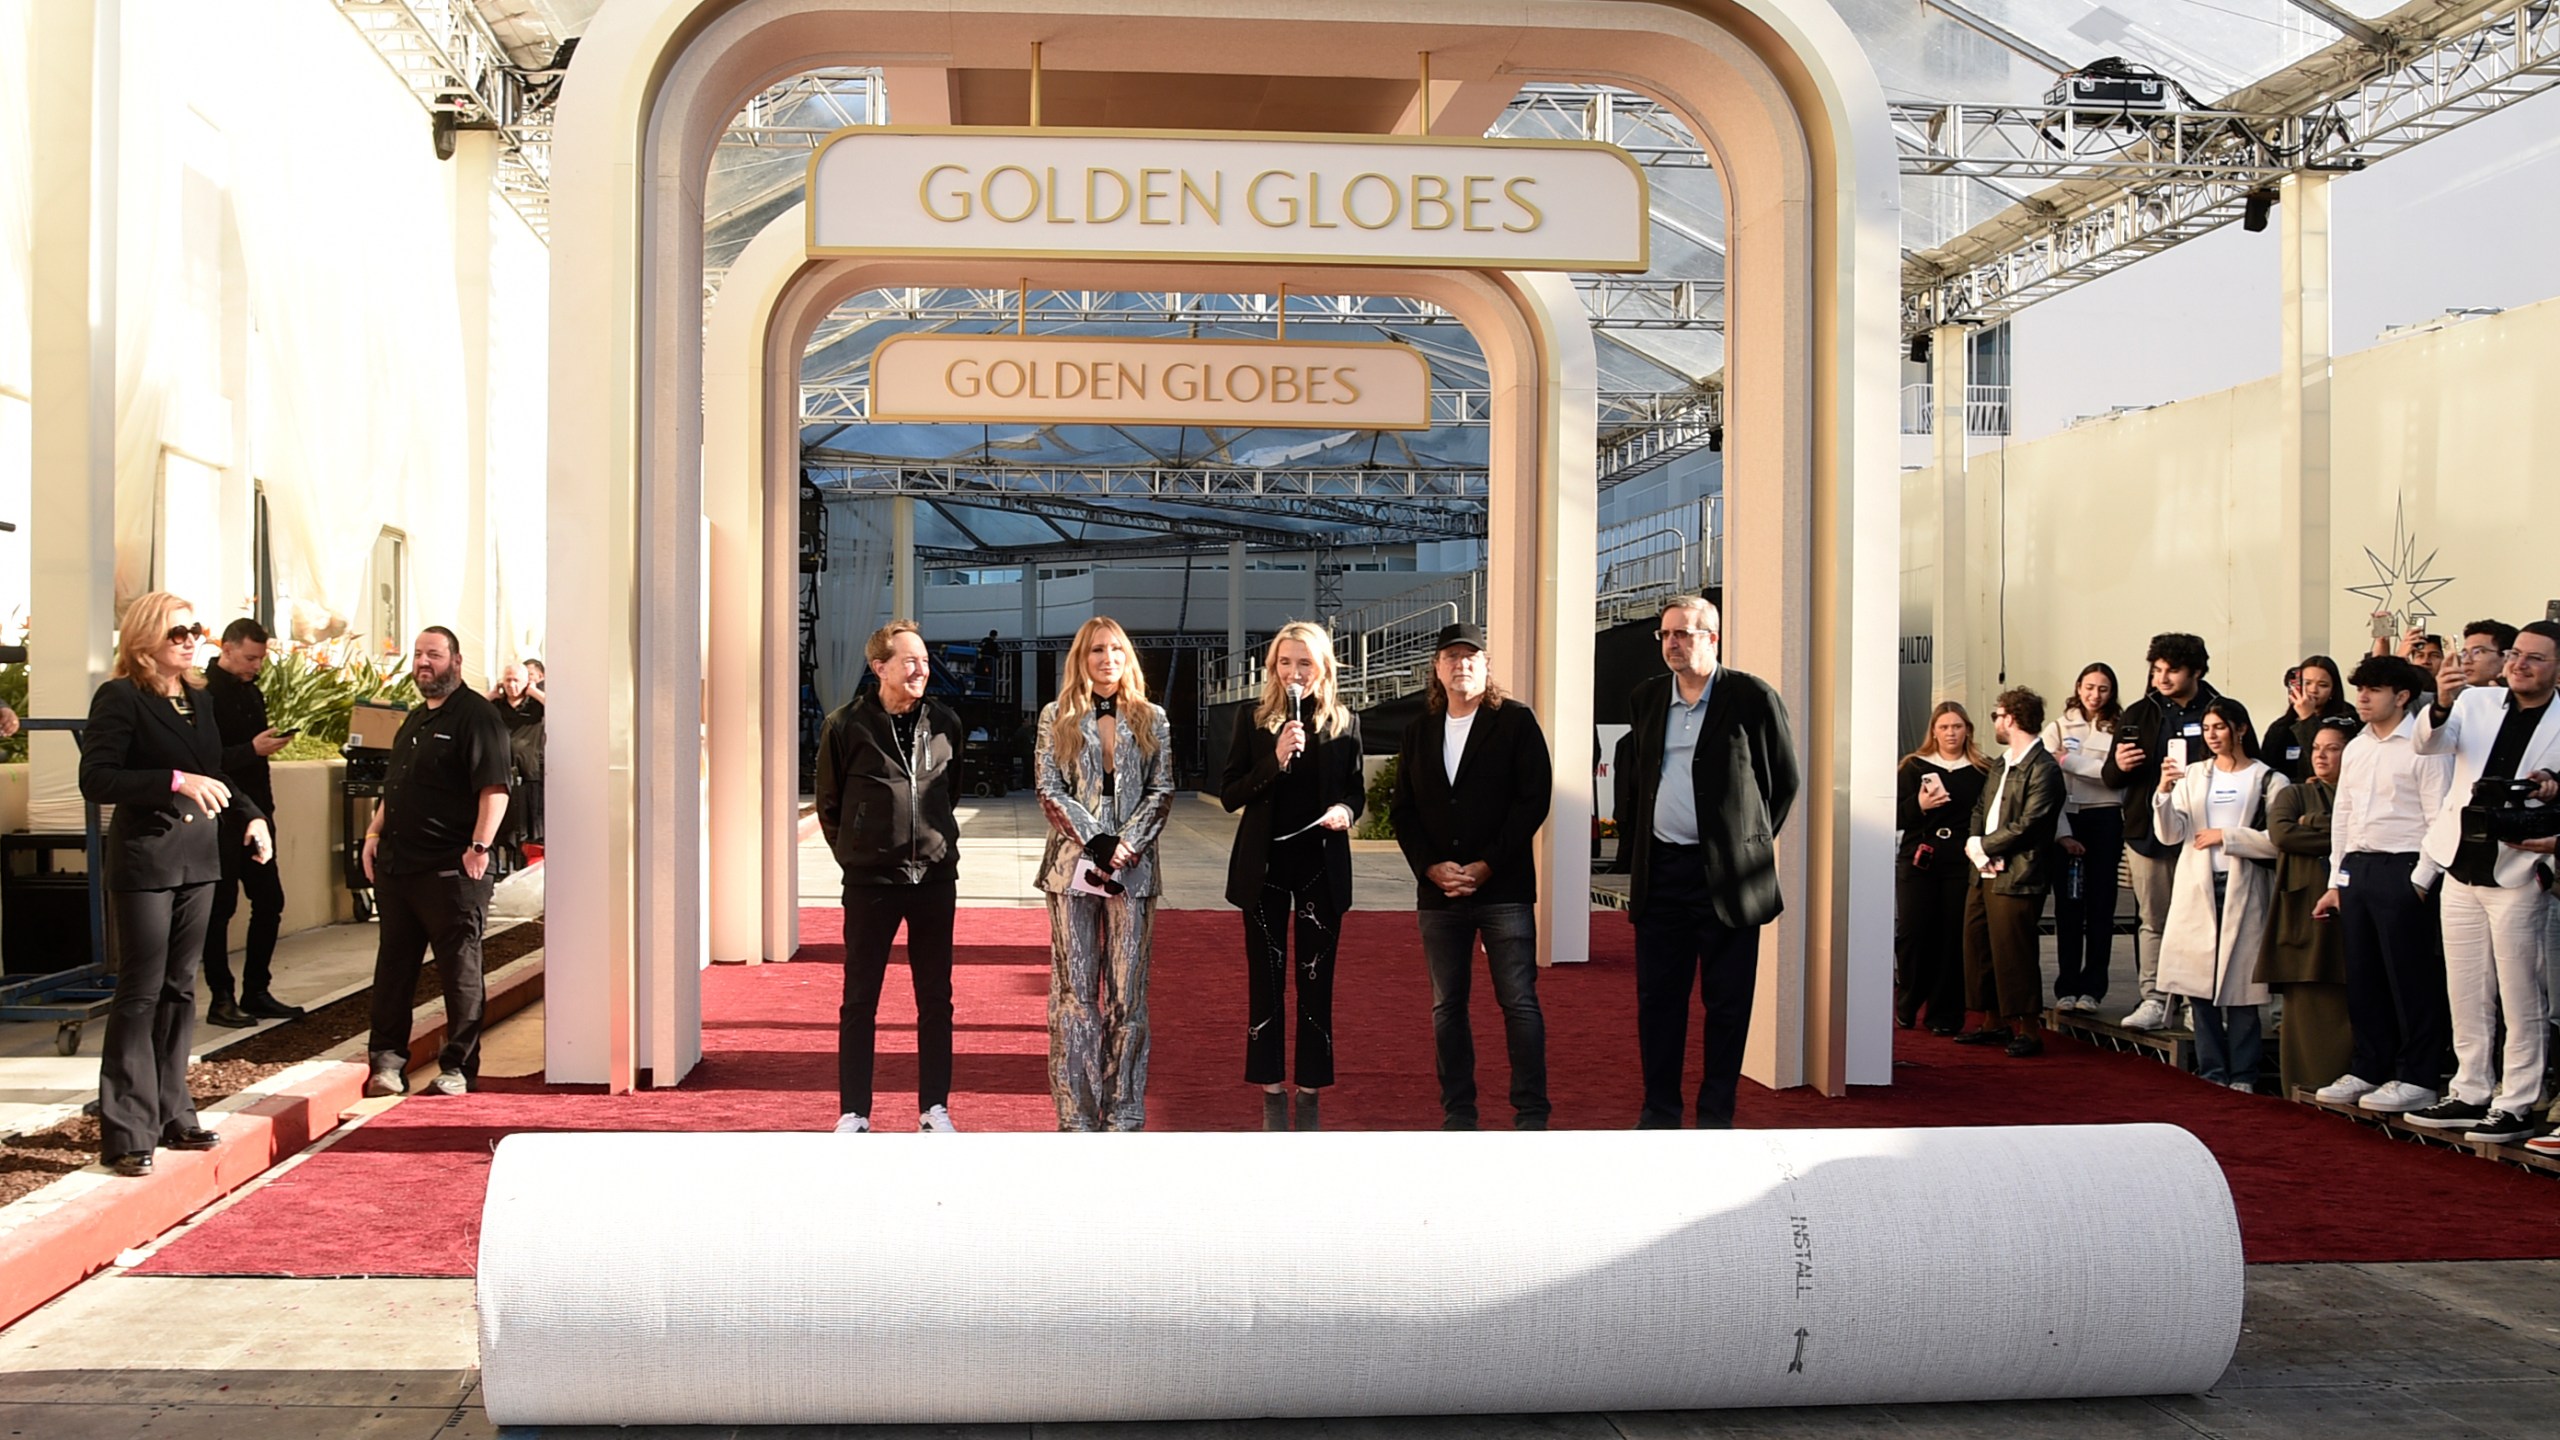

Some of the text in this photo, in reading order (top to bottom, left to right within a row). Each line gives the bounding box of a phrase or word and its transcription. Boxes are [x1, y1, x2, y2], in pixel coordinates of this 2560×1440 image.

[917, 163, 1543, 233] GOLDEN GLOBES
[945, 359, 1360, 405] GOLDEN GLOBES
[1790, 1215, 1813, 1300] INSTALL
